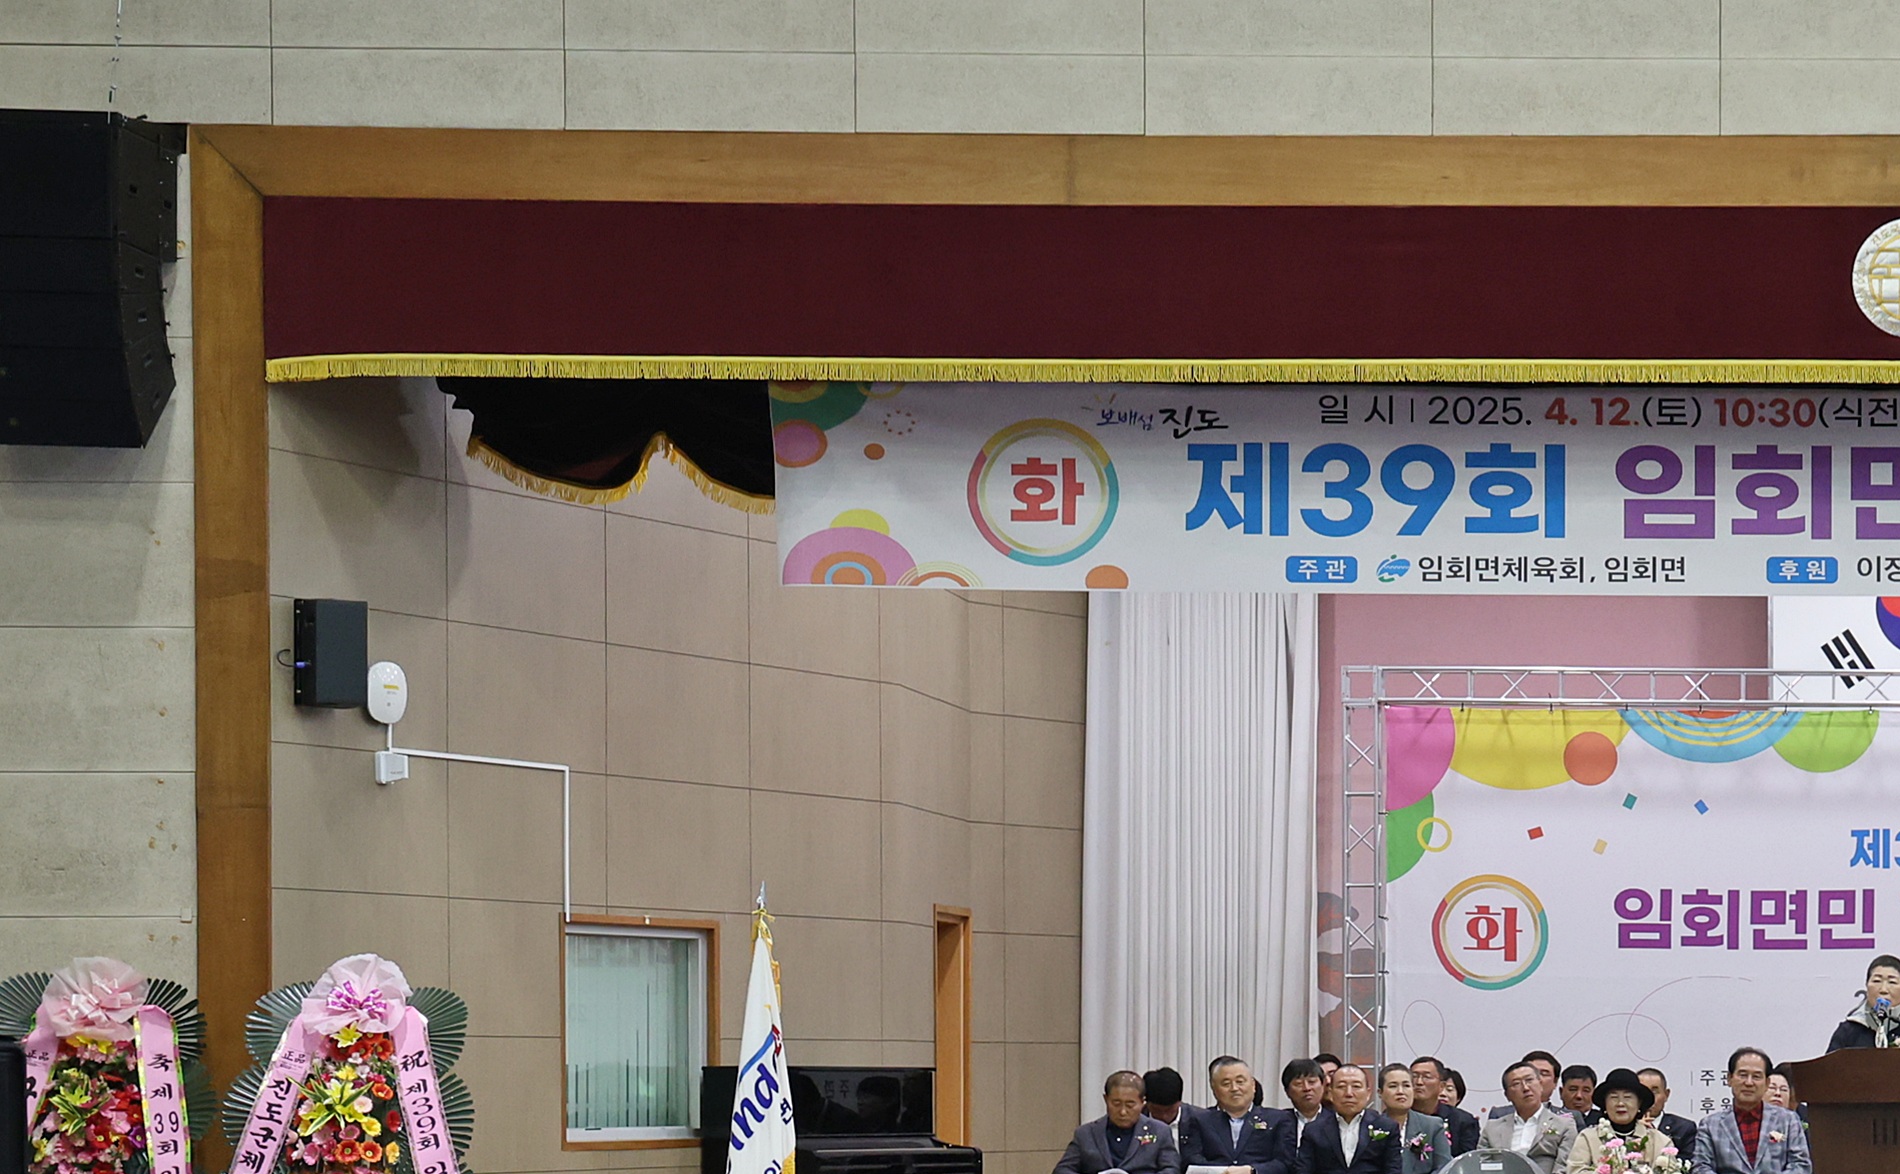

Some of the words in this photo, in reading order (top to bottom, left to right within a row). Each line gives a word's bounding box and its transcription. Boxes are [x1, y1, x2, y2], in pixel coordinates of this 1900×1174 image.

[1160, 405, 1229, 439] 진도
[1428, 396, 1532, 426] 2025.
[1544, 397, 1577, 425] 4.
[1010, 456, 1084, 526] 화
[1186, 442, 1566, 538] 제39회
[1418, 556, 1595, 583] 임회면체육회,
[1604, 556, 1686, 582] 임회면
[1463, 905, 1523, 962] 화
[1613, 888, 1875, 950] 임회면민
